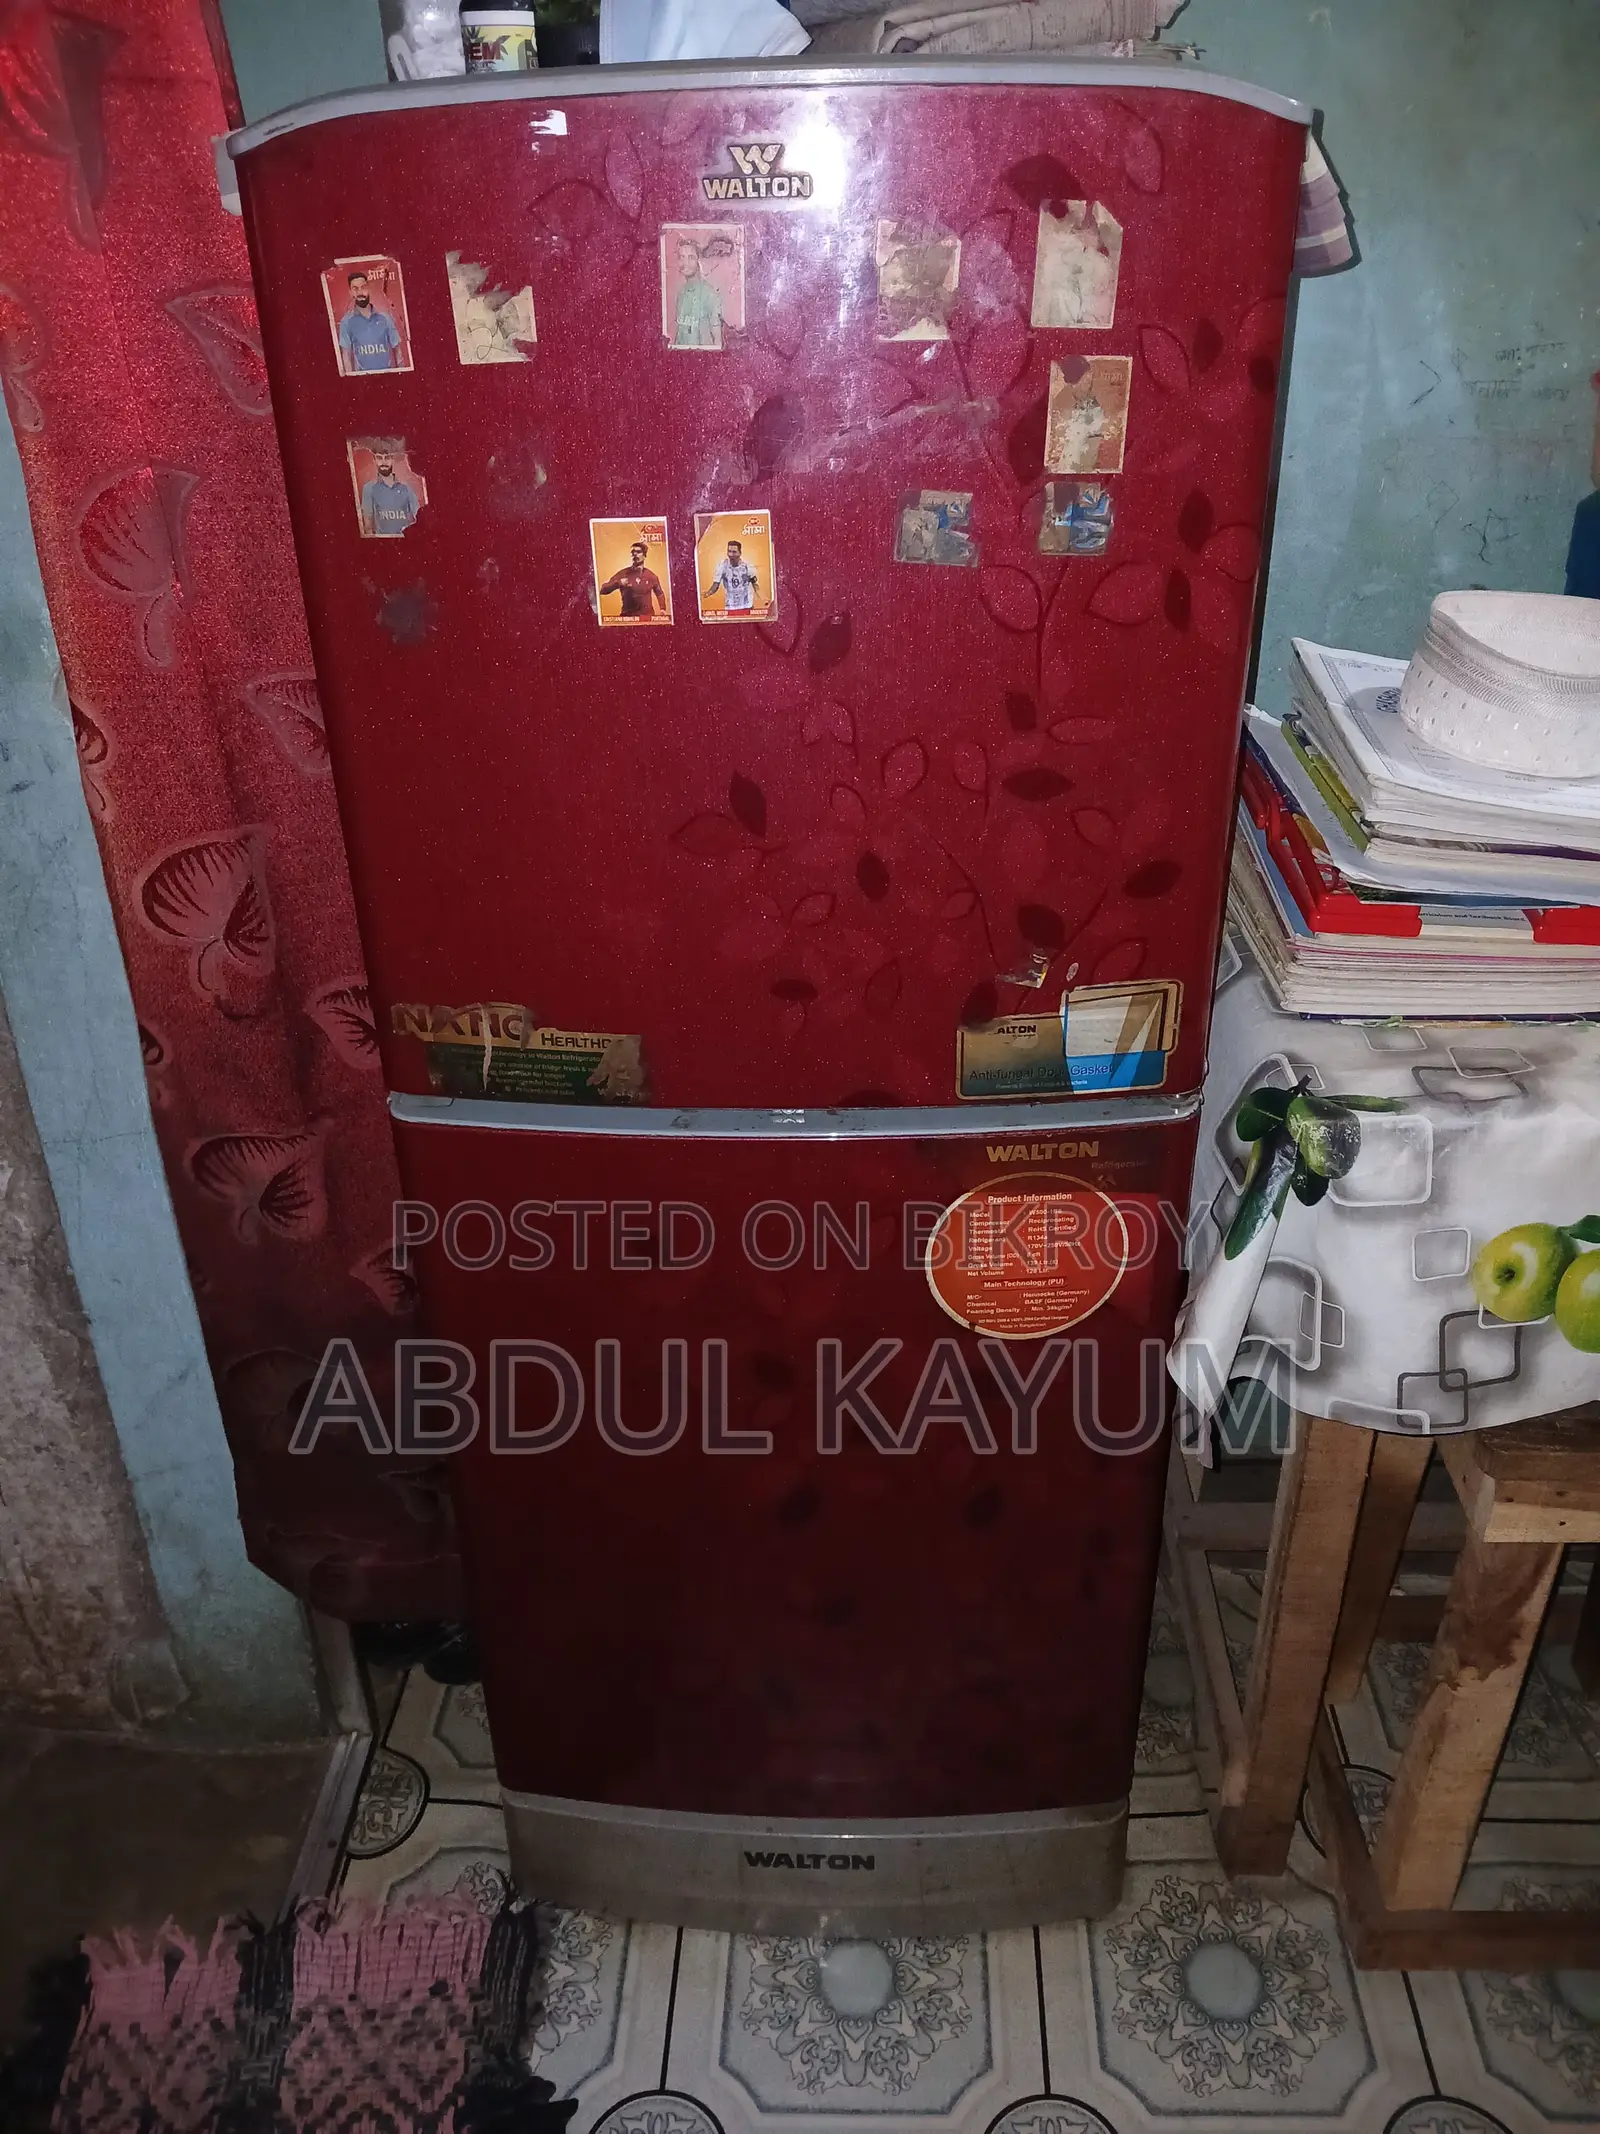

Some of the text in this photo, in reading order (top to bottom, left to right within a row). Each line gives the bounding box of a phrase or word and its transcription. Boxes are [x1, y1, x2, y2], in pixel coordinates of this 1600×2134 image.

[702, 176, 811, 199] WALTON
[997, 1025, 1037, 1034] ALTON
[970, 1068, 1034, 1080] Anti-fungal
[986, 1141, 1099, 1162] WALTON
[988, 1192, 1072, 1204] Product Information
[1028, 1216, 1075, 1224] Reciprocating
[1003, 1279, 1047, 1287] Technology
[1047, 1278, 1065, 1286] (PU)
[1056, 1289, 1090, 1297] (Germany)
[1044, 1297, 1078, 1305] (Germany)
[966, 1308, 994, 1316] Foaming
[744, 1851, 876, 1870] WALTON
